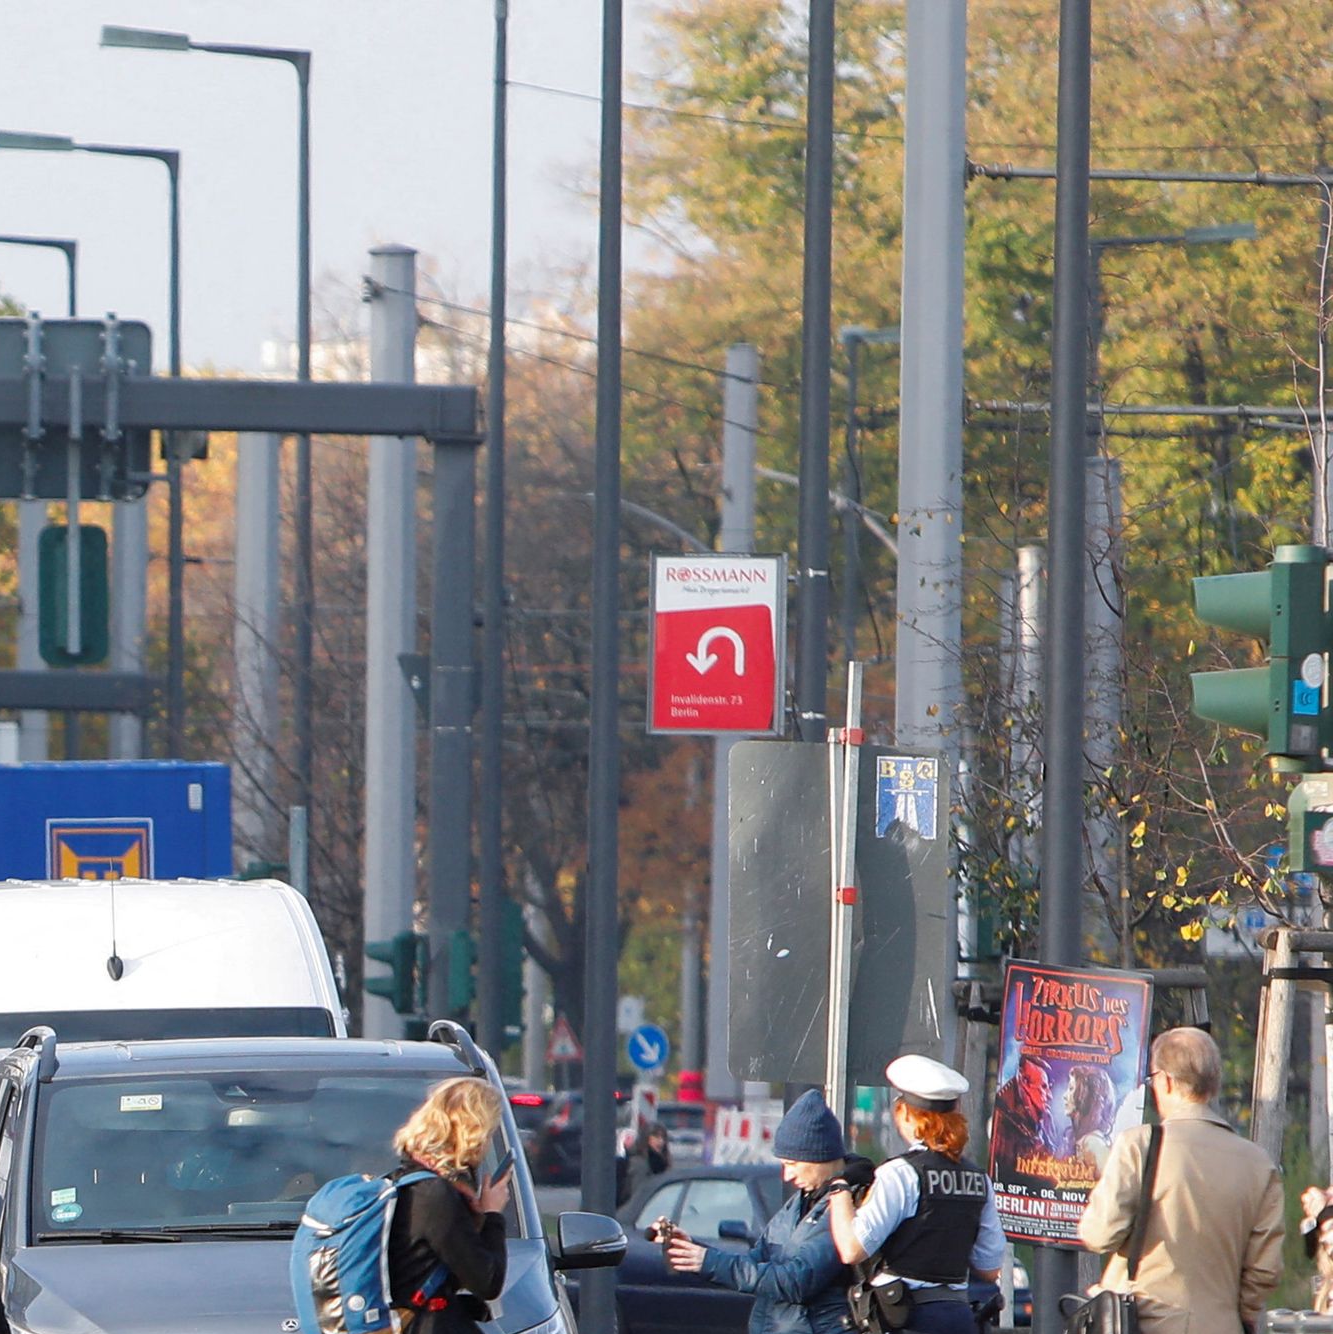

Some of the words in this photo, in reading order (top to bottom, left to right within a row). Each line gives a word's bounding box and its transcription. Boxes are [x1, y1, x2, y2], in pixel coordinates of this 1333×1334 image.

[671, 706, 699, 718] Berlin
[1032, 976, 1101, 1012] ZIRKUS
[1015, 982, 1128, 1055] HORRORS
[1008, 1184, 1030, 1197] SEPT.
[1062, 1192, 1089, 1203] NOV.
[995, 1195, 1045, 1217] BERLIN
